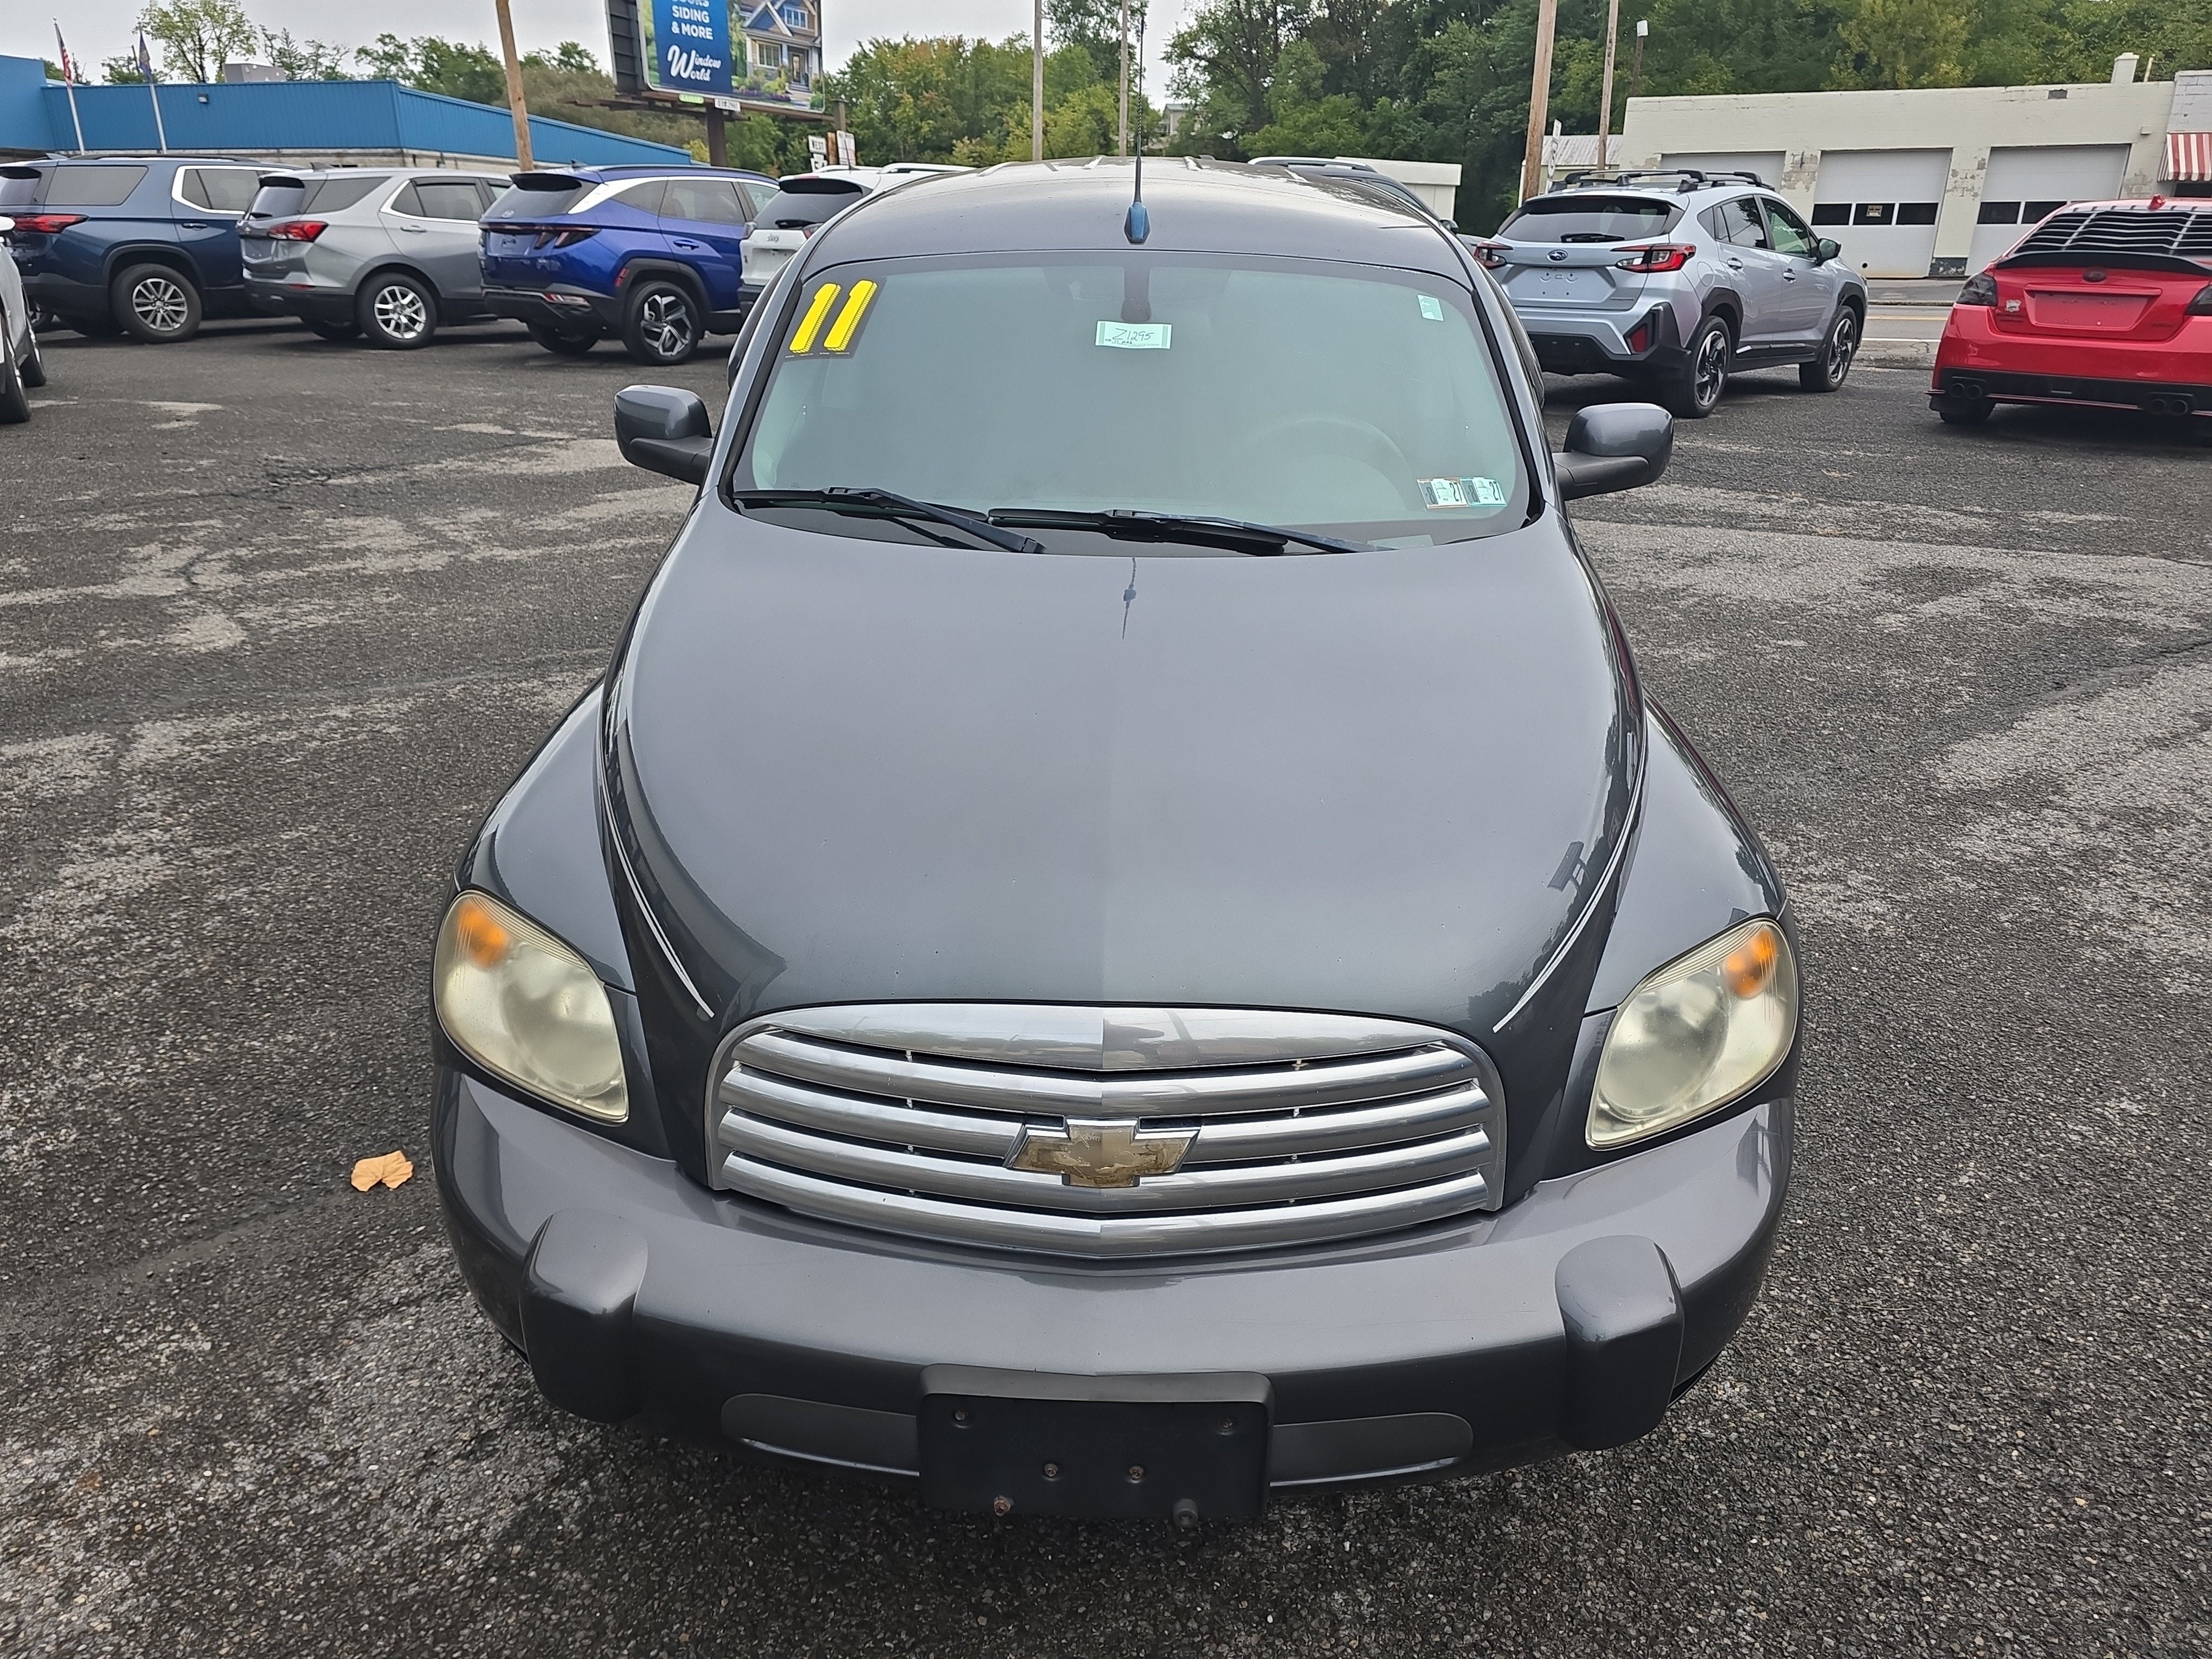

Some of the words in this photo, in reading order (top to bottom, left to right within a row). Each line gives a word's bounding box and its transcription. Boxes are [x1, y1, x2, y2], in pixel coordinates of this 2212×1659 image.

[672, 5, 710, 23] SIDING
[671, 21, 680, 34] &
[681, 22, 713, 40] MORE
[667, 45, 722, 79] Window
[789, 280, 878, 353] 11
[1112, 327, 1155, 341] Z1295
